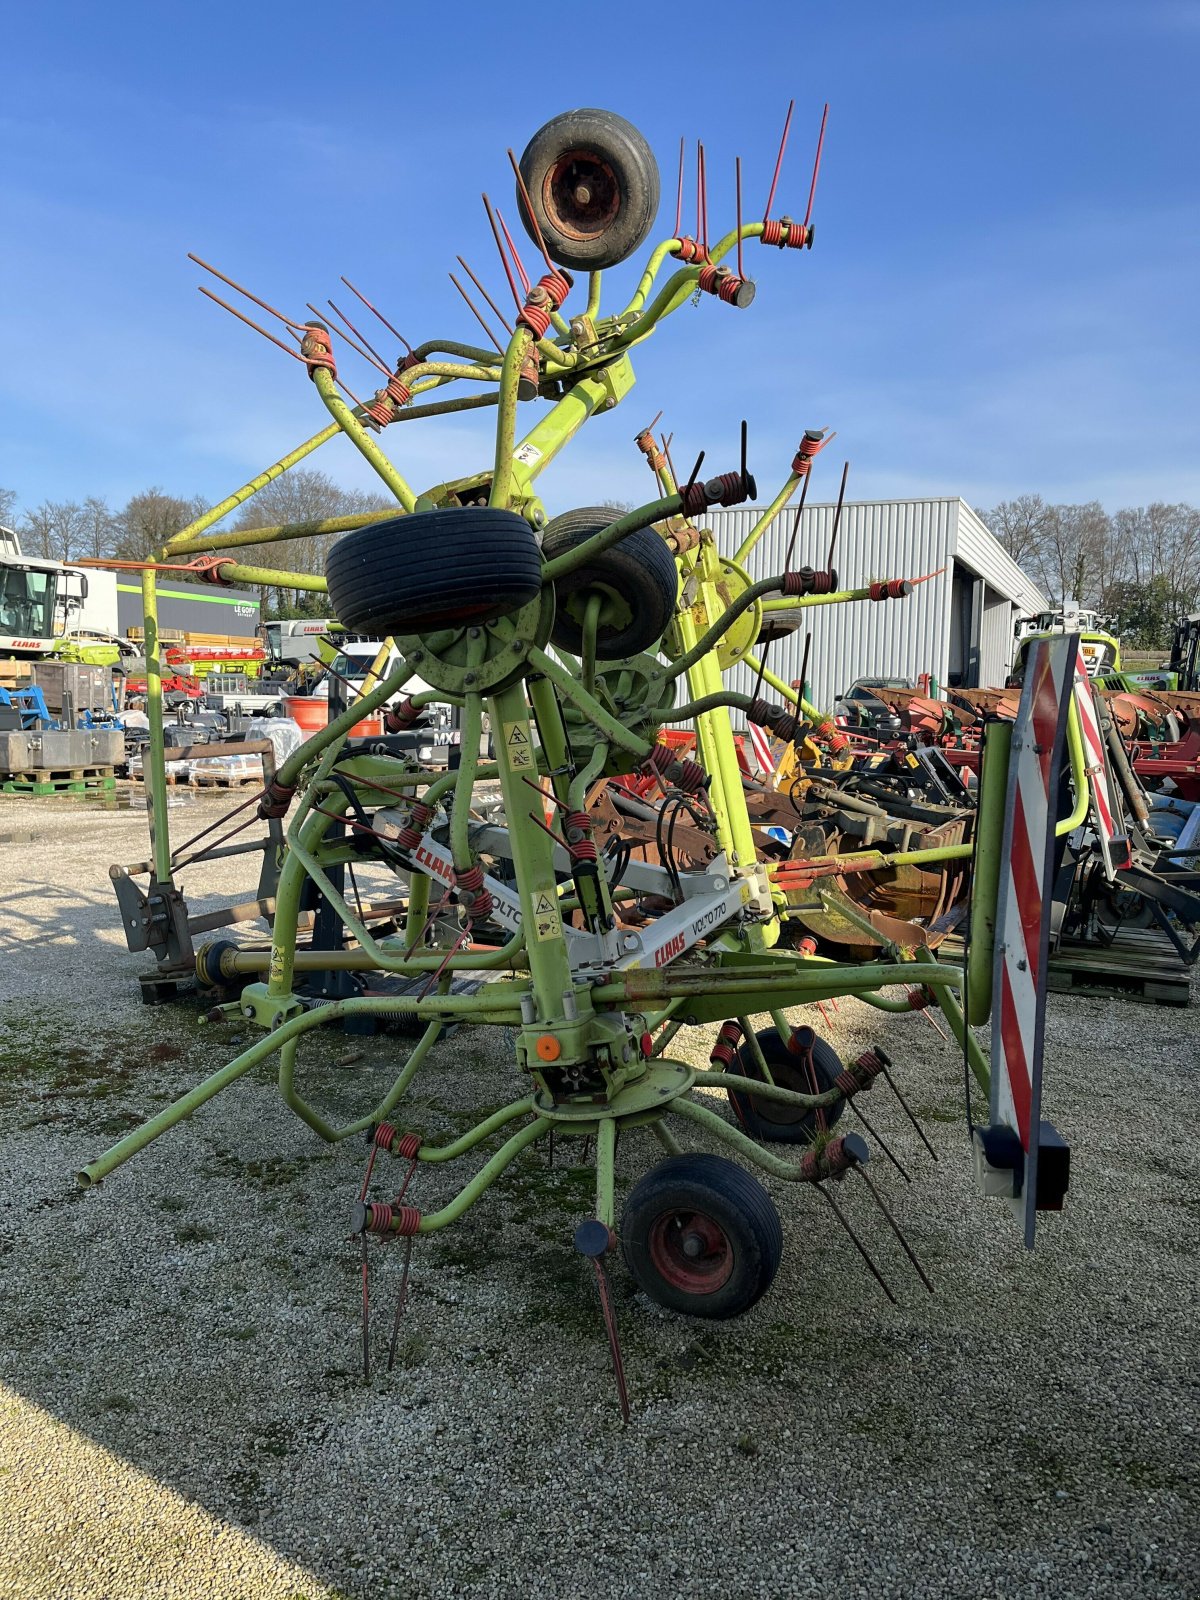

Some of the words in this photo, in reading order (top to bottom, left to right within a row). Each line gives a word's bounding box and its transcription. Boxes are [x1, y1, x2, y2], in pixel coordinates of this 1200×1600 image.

[234, 605, 241, 613] LE
[241, 606, 256, 614] GOFF
[11, 640, 42, 649] CLAAS
[434, 732, 454, 746] MX
[415, 847, 456, 882] CLAA
[489, 892, 522, 925] OLTO
[654, 931, 686, 968] CLAAS
[692, 911, 714, 936] VOLTO
[713, 902, 727, 921] 770
